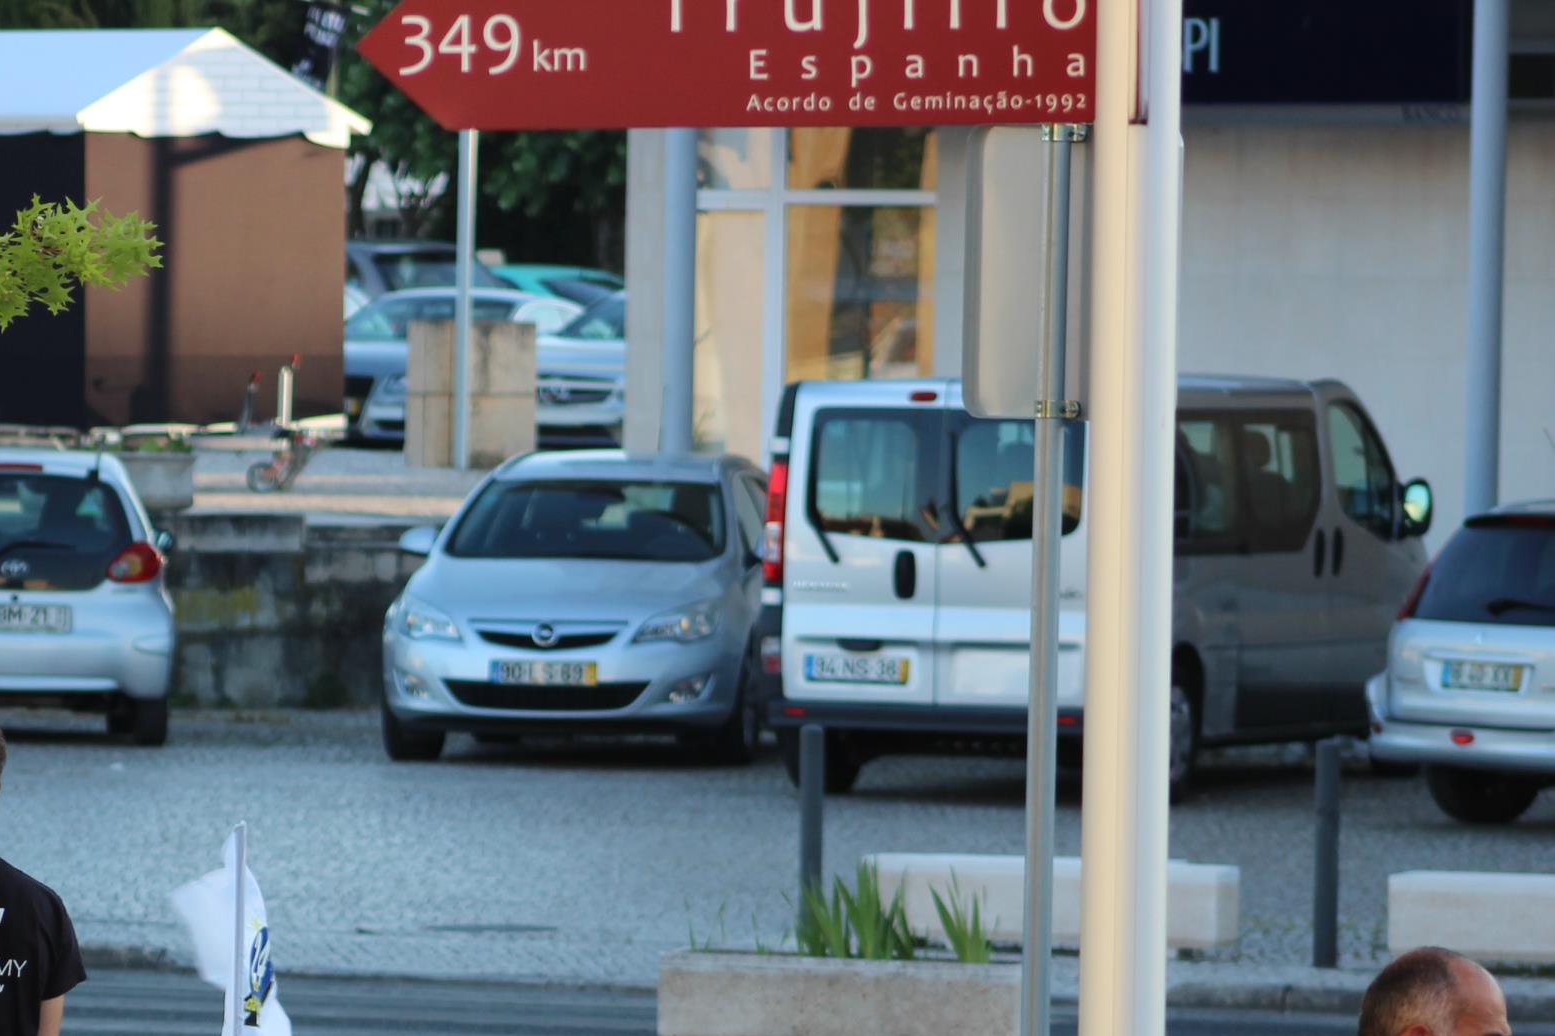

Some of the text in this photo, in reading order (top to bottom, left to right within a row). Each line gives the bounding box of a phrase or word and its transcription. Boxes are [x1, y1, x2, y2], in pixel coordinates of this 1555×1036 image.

[398, 13, 521, 76] 349
[532, 39, 587, 71] km
[748, 45, 1086, 87] Espanha
[746, 90, 1087, 115] Acordo de Geminação-1992
